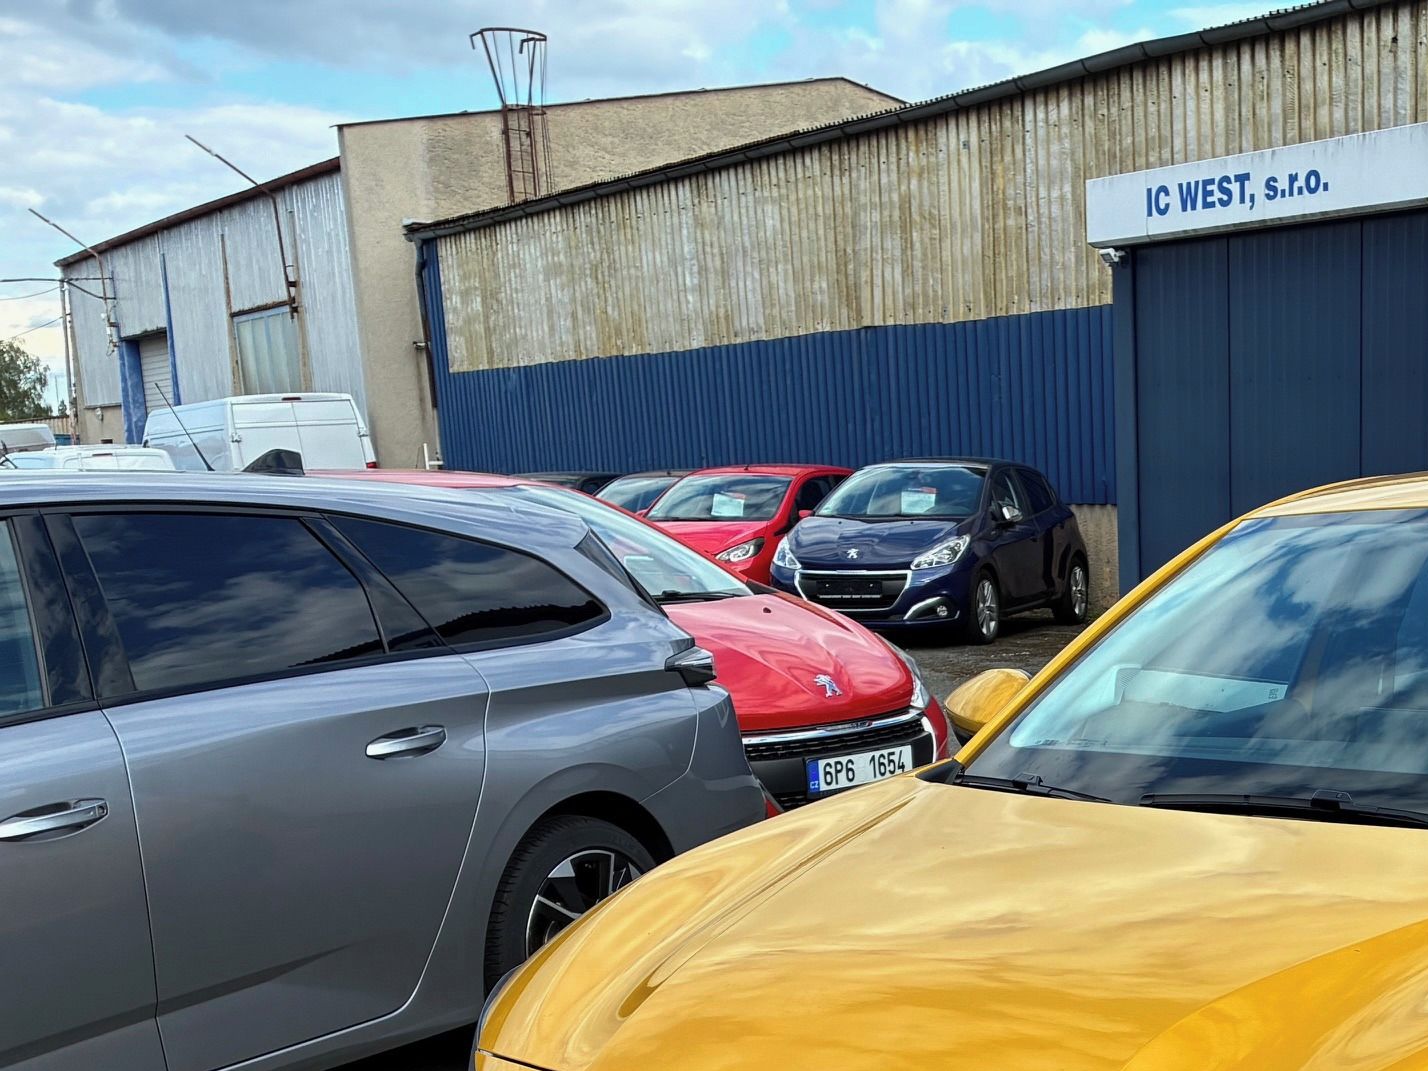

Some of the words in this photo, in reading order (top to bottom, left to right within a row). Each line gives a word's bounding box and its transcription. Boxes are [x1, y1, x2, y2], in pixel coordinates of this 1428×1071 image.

[1146, 185, 1170, 218] IC
[1177, 172, 1255, 213] WEST,
[1264, 169, 1329, 201] s.r.o.
[809, 780, 819, 789] CZ
[823, 759, 855, 786] 6P6
[869, 750, 906, 779] 1654
